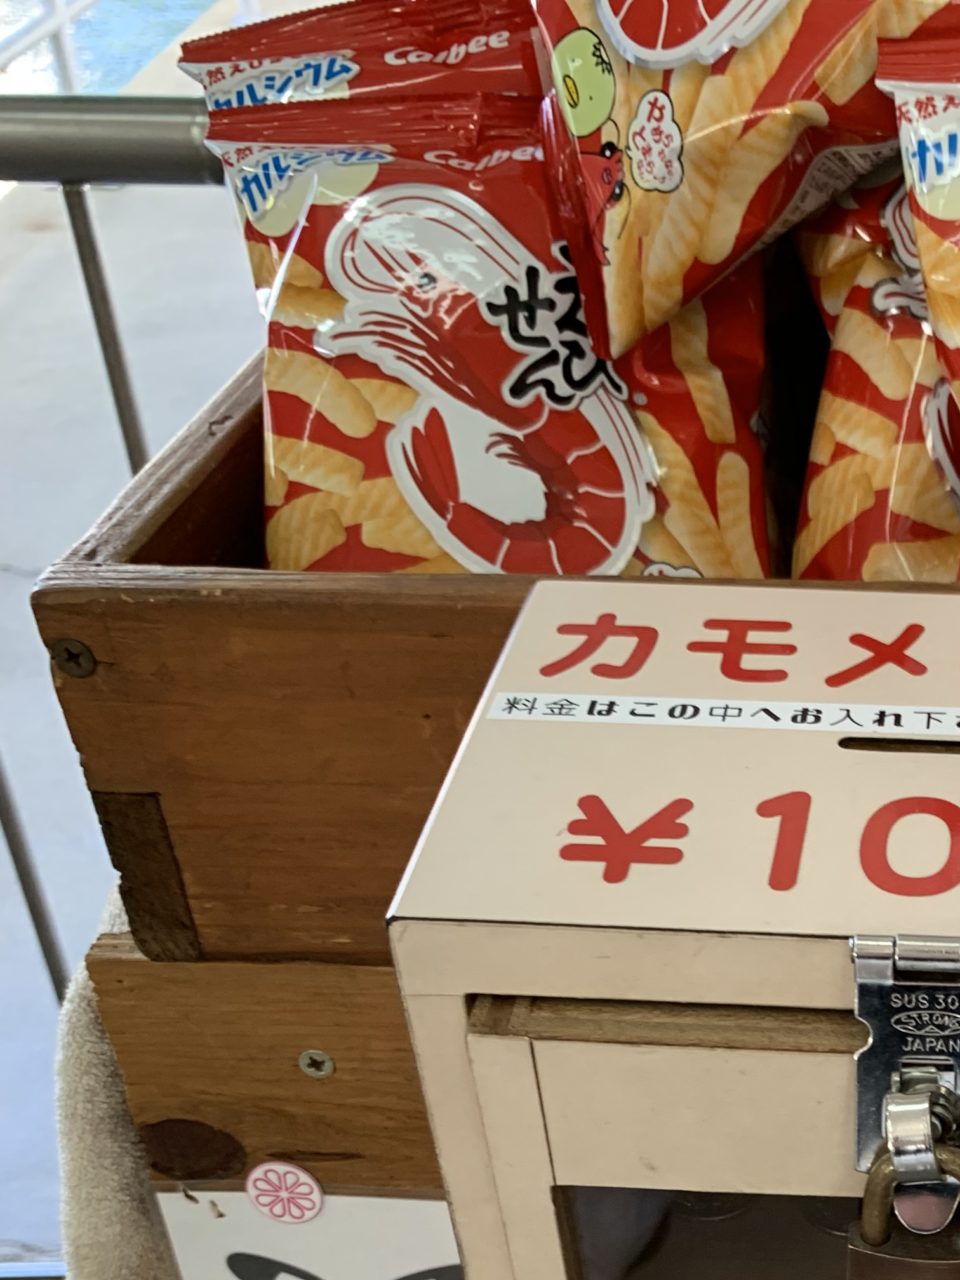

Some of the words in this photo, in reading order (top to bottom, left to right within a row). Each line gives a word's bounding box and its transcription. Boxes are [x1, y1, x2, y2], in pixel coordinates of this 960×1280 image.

[383, 30, 511, 65] Calbee
[890, 993, 930, 1009] SUS
[901, 1036, 960, 1053] JAPAN
